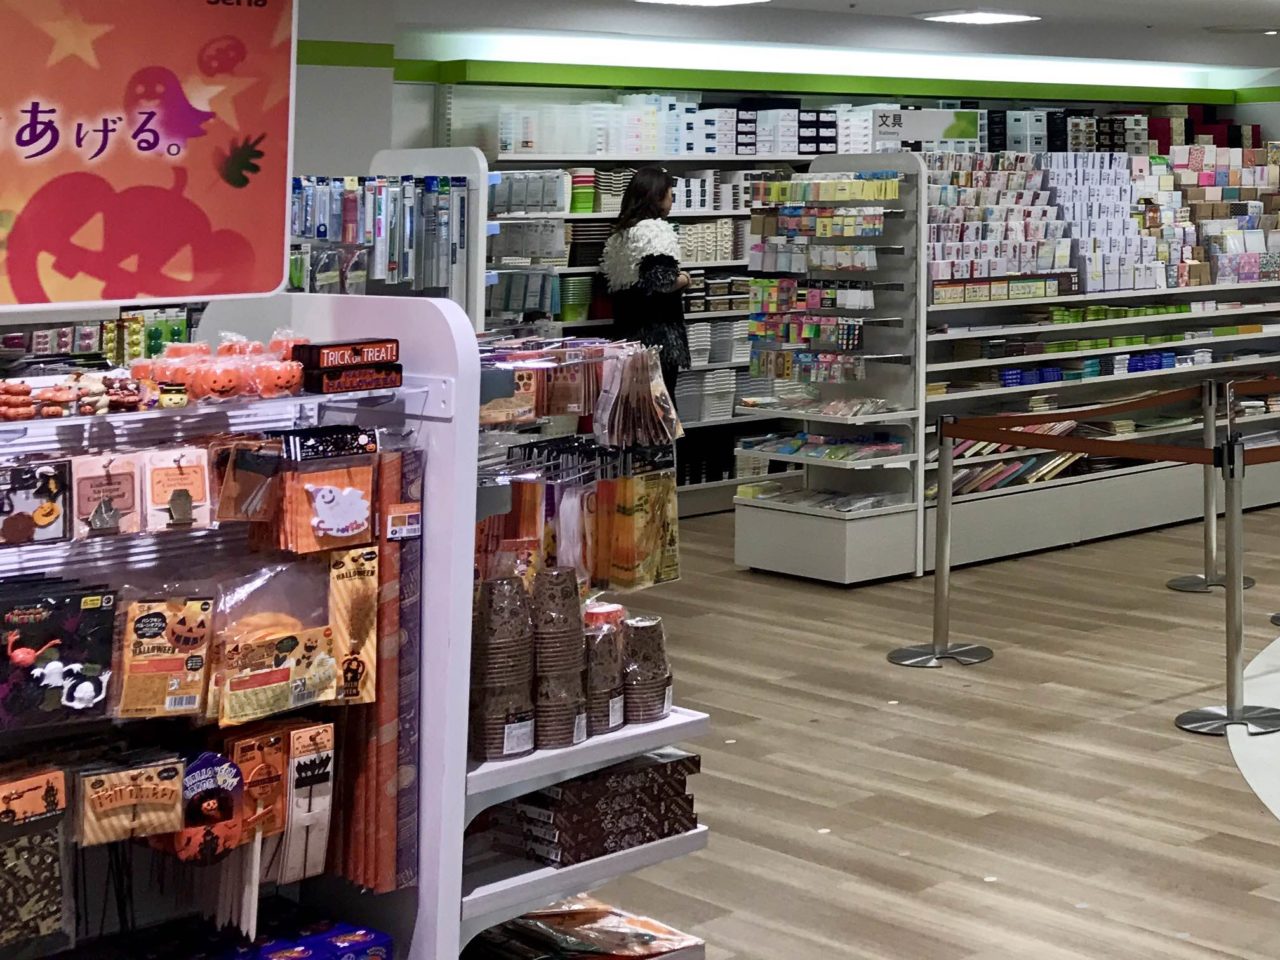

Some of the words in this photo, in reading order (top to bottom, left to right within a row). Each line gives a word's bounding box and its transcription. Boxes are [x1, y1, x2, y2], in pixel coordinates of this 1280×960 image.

[878, 113, 903, 128] 文具
[322, 350, 351, 367] TRICK
[362, 344, 397, 362] TREAT!
